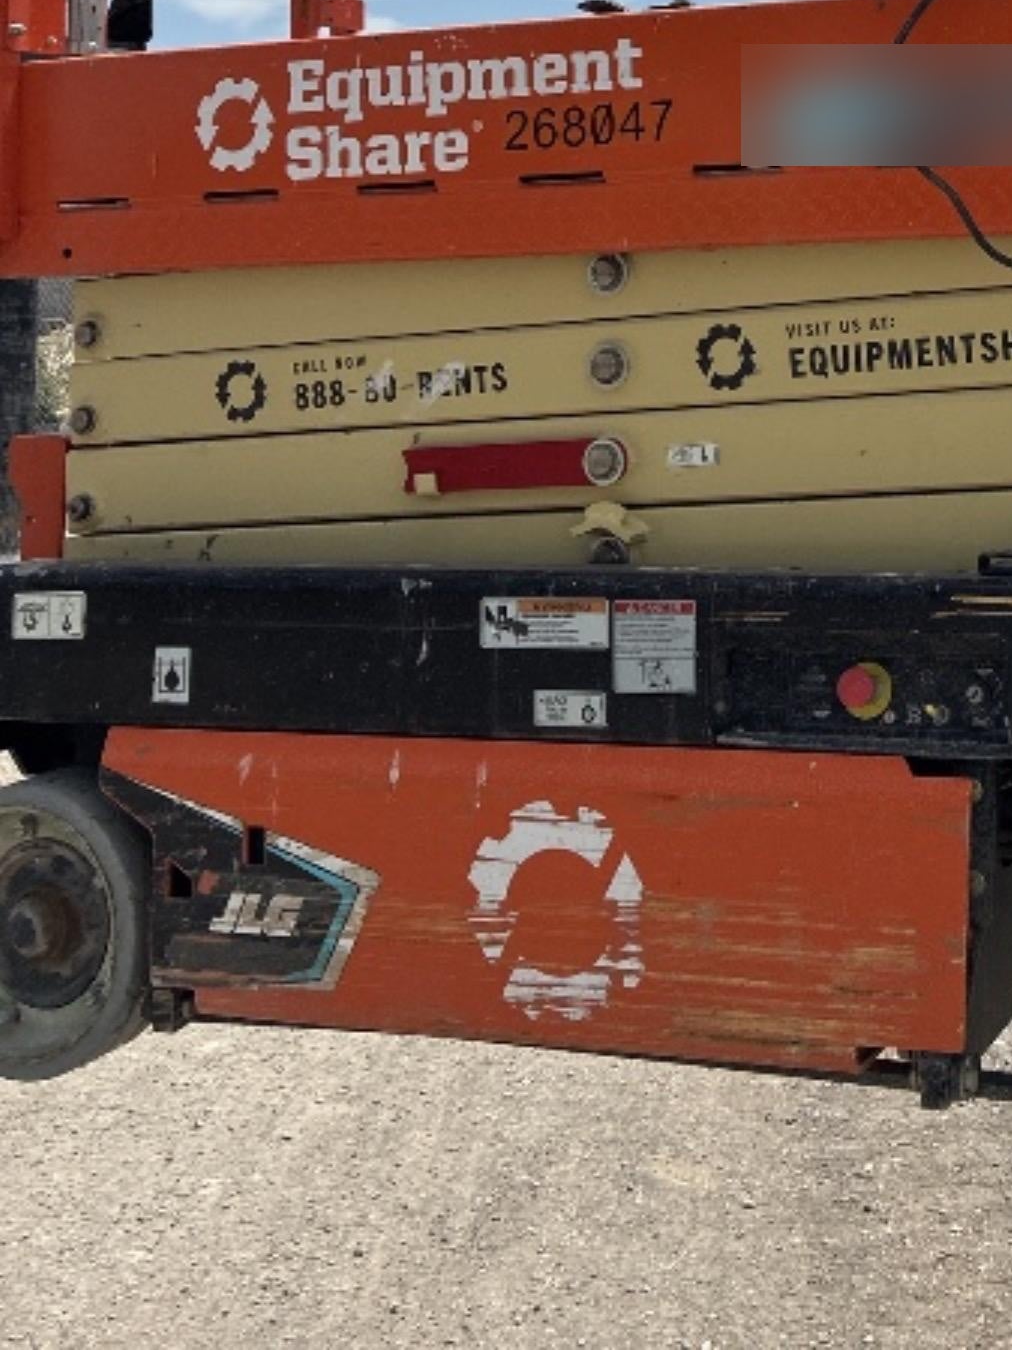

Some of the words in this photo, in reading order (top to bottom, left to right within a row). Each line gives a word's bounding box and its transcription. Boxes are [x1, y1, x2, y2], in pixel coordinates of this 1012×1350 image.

[287, 38, 643, 123] Equipment
[504, 98, 674, 151] 268047
[285, 125, 469, 181] Share
[785, 321, 832, 339] VISIT
[838, 318, 862, 334] US
[868, 317, 896, 332] AT:
[292, 358, 328, 376] CALL
